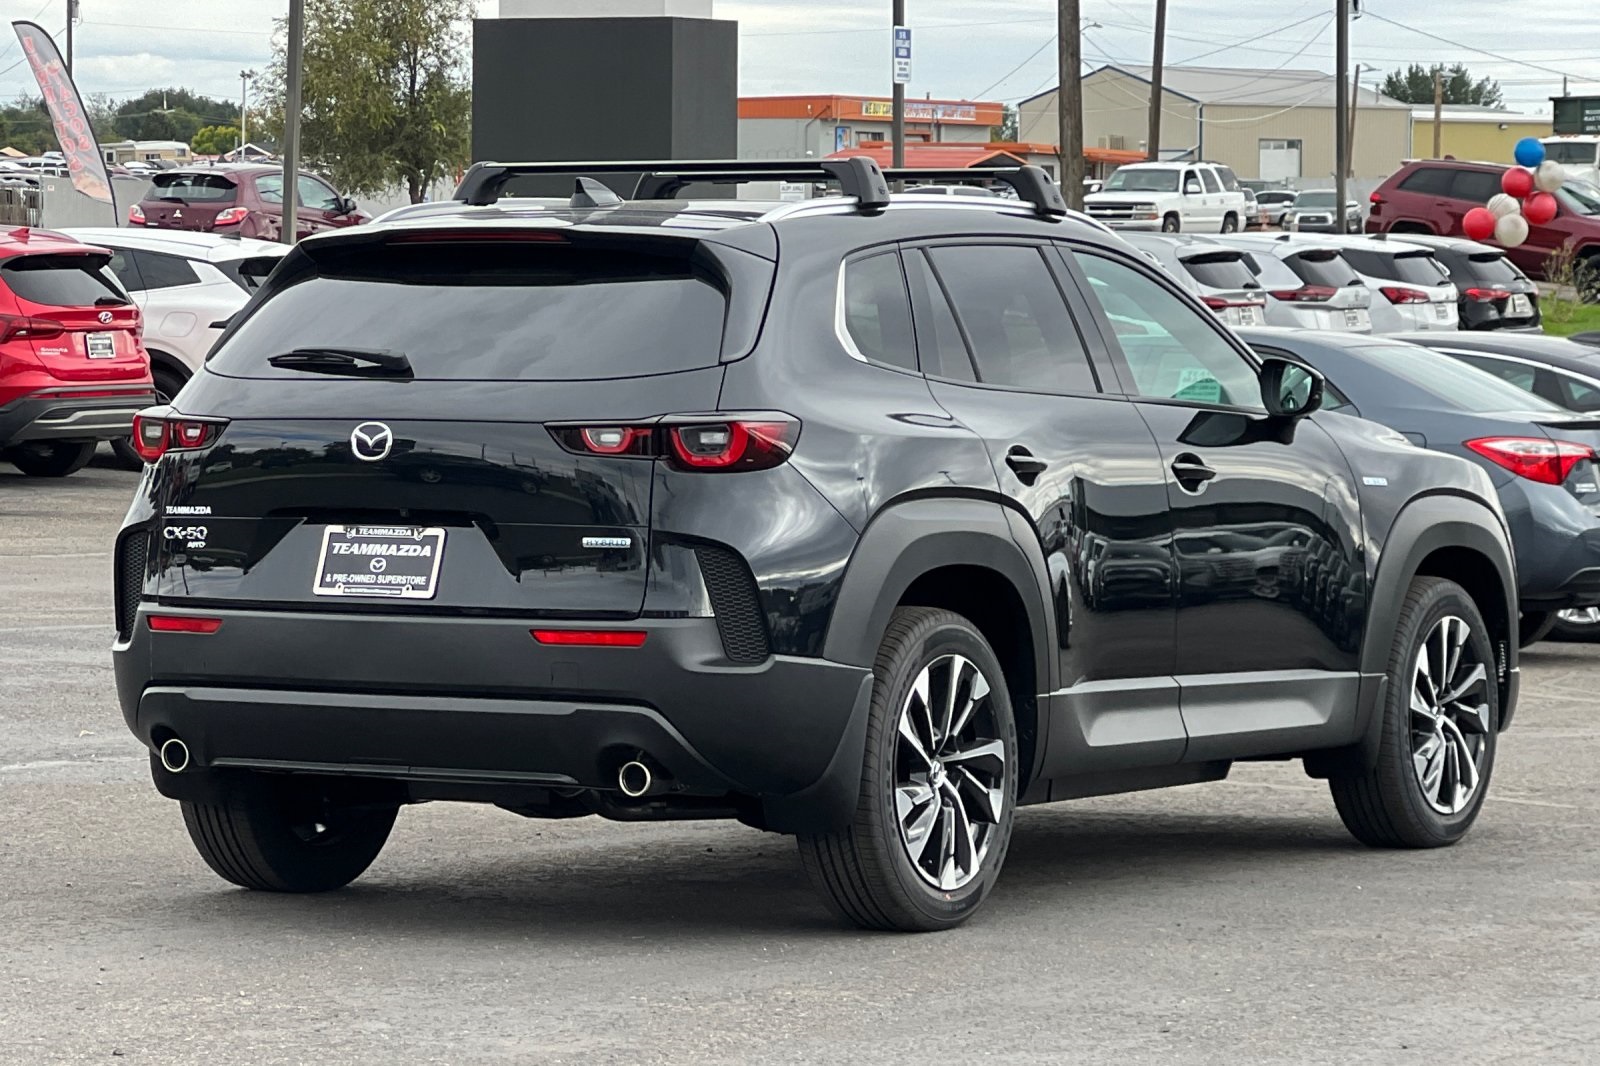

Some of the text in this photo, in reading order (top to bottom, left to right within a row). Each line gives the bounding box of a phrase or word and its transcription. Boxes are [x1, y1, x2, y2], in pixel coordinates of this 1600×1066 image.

[165, 506, 211, 514] TEAMMAZDA
[163, 526, 208, 540] CX-50
[359, 528, 412, 536] TEAMMAZDA
[332, 543, 432, 557] TEAMMAZDA
[325, 574, 427, 586] & PRE-OWNED SUPERSTORE
